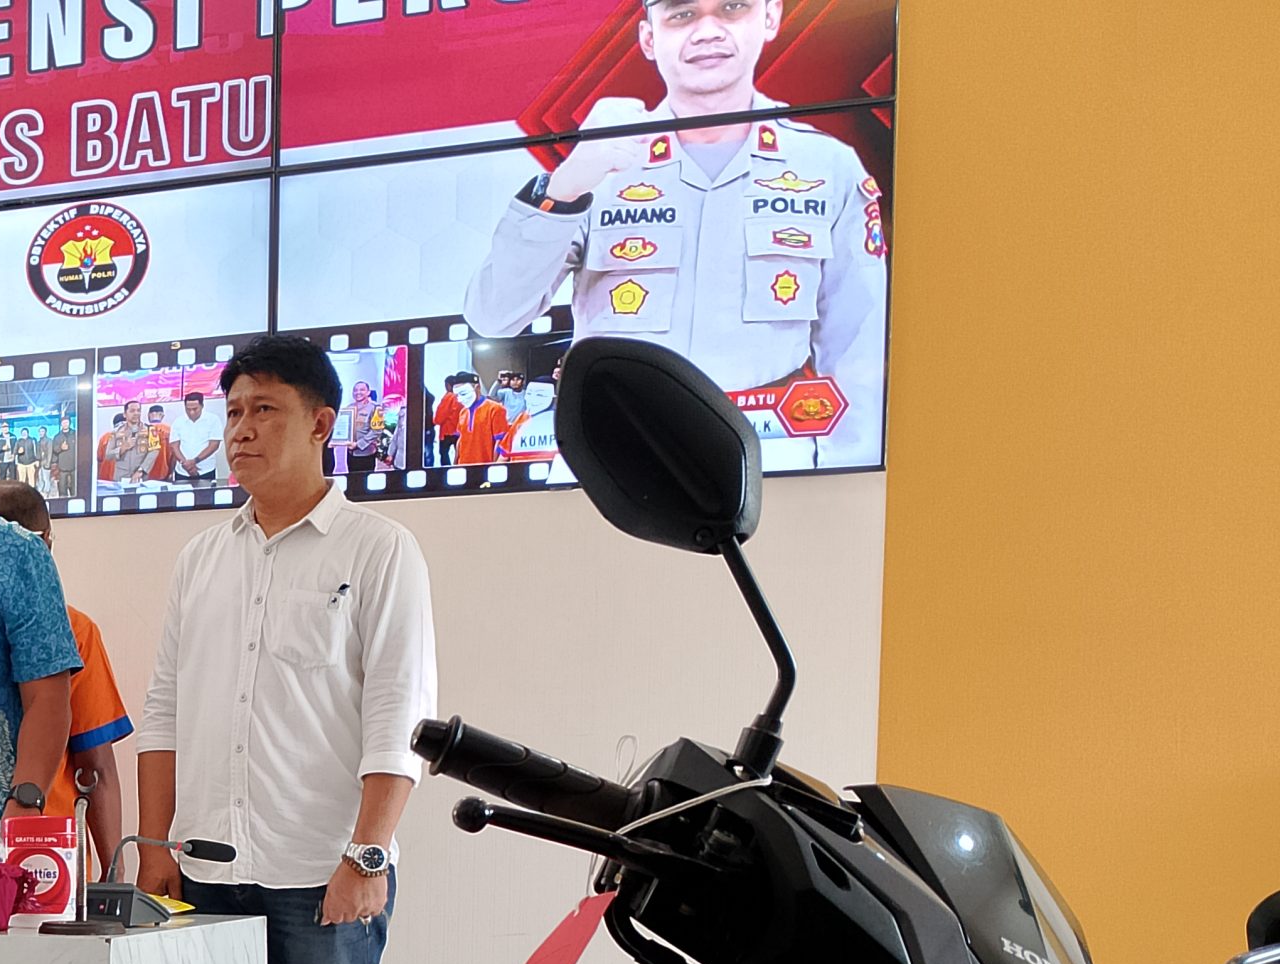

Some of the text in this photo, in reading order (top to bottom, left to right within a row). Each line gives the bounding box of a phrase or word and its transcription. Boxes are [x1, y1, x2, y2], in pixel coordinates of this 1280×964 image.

[70, 75, 273, 177] BATU
[599, 197, 827, 227] DANANG POLRI
[29, 204, 147, 266] OBYEKTIF DIPERCAYA
[91, 270, 116, 279] POLRI
[45, 287, 130, 315] PARTISIPASI
[737, 393, 776, 407] BATU
[520, 434, 557, 448] KOMP
